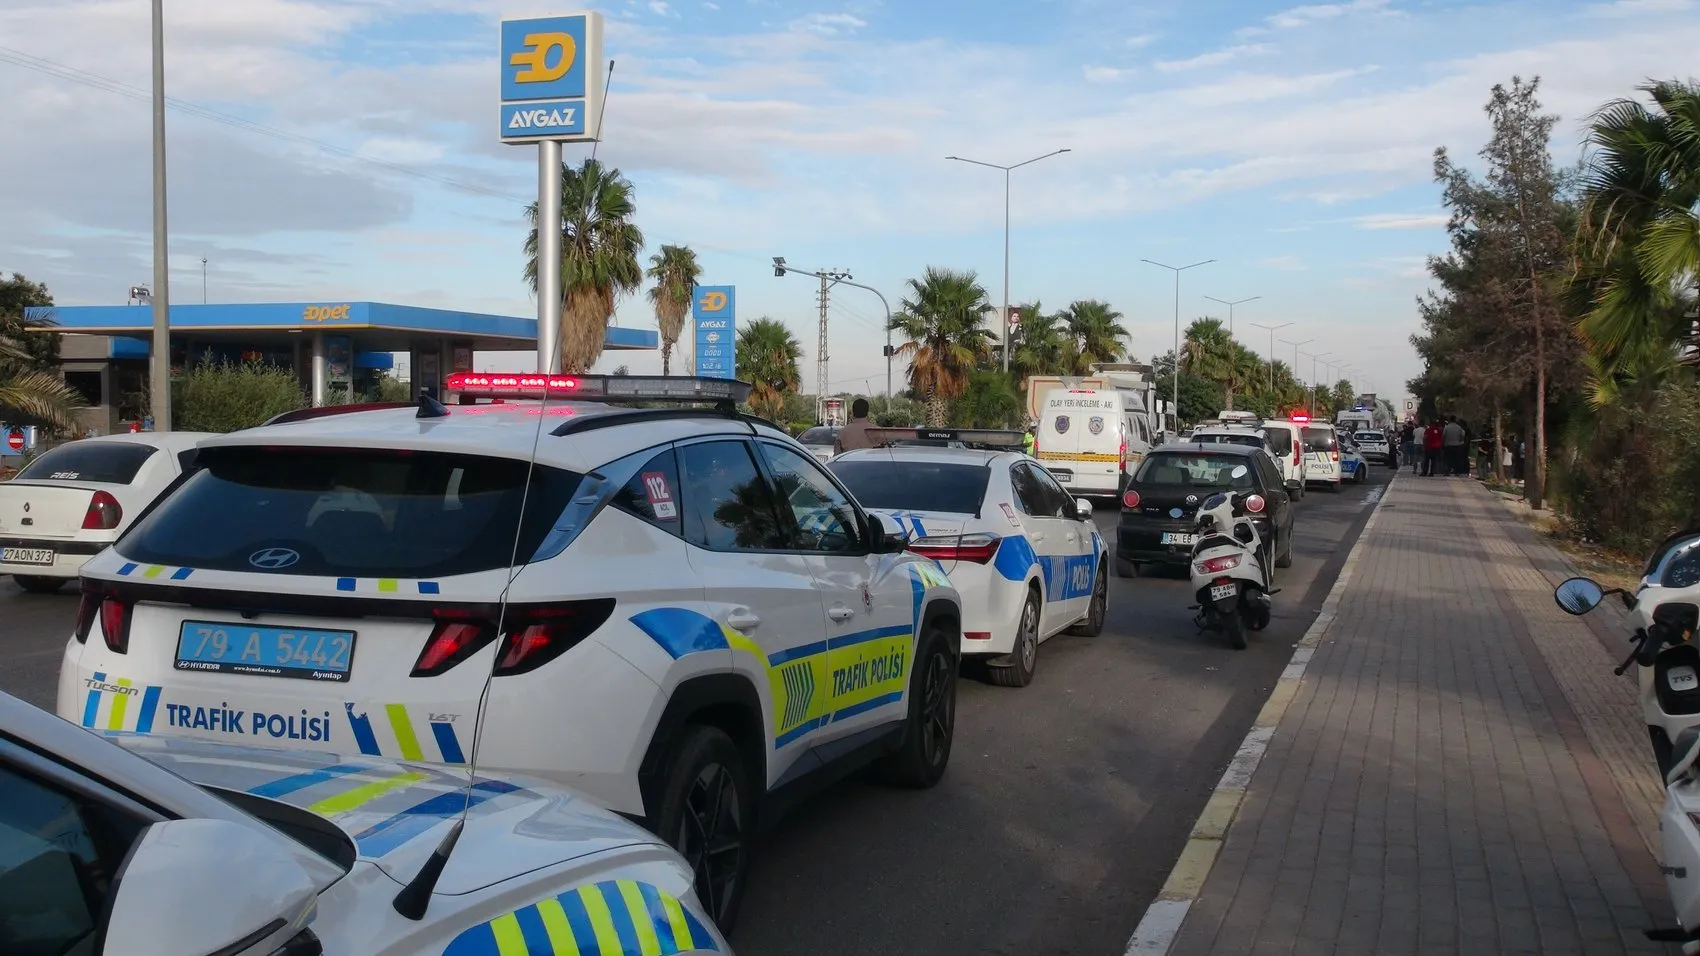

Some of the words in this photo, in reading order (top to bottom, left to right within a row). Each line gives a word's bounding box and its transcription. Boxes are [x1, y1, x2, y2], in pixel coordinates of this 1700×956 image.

[508, 108, 576, 129] AYGAZ
[700, 320, 727, 328] AYGAZ
[1050, 399, 1062, 408] OLAY
[1075, 398, 1099, 408] İNCELEME
[1407, 401, 1413, 410] D
[646, 476, 669, 499] 112
[1169, 534, 1178, 542] 34
[1072, 558, 1090, 591] POLİS
[194, 628, 228, 660] 79
[240, 631, 261, 662] A
[276, 633, 350, 668] 5442
[190, 662, 221, 670] HYUNDAI
[832, 653, 869, 698] TRAFİK
[871, 645, 905, 685] POLİSİ
[166, 701, 245, 734] TRAFİK
[252, 708, 330, 742] POLİSİ
